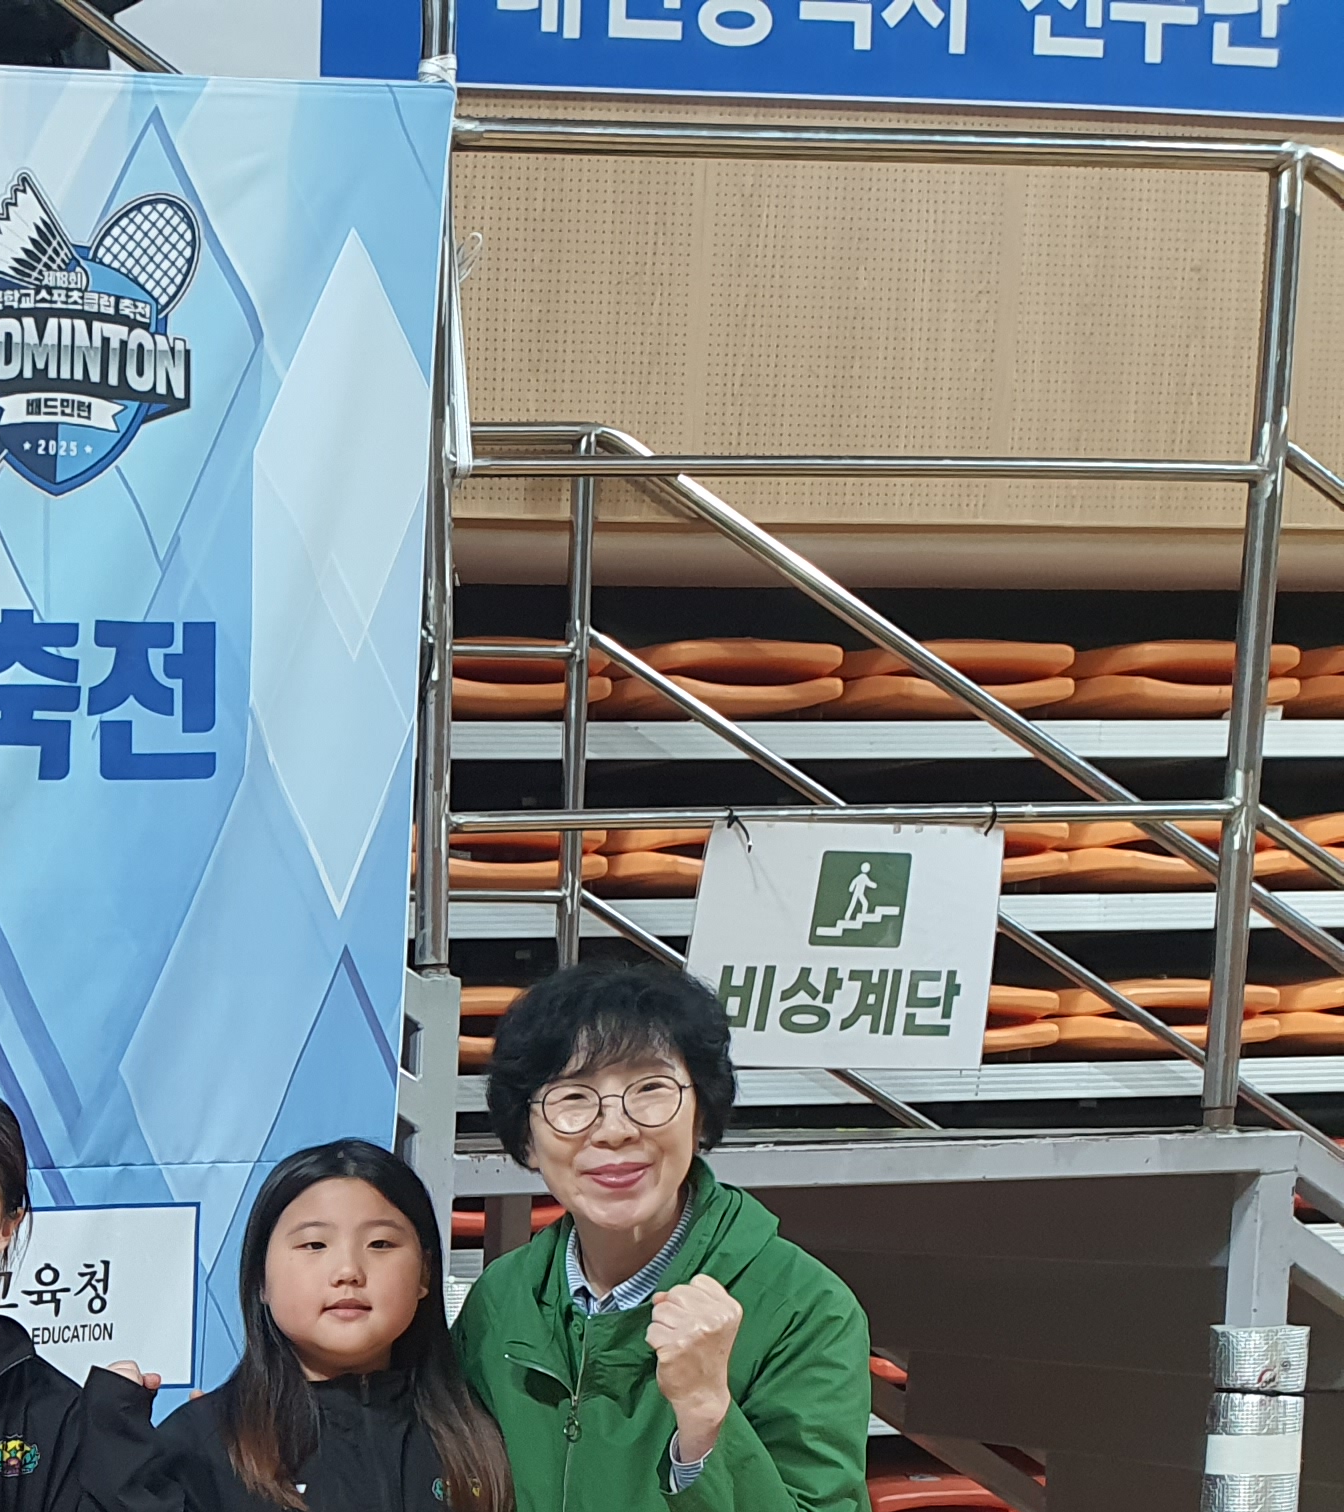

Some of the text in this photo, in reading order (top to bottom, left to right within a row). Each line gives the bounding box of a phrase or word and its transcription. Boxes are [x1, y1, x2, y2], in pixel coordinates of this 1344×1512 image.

[25, 397, 92, 420] 배드민턴
[36, 439, 78, 457] 2025
[717, 965, 962, 1037] 비상계단
[31, 1322, 113, 1345] EDUCATION
